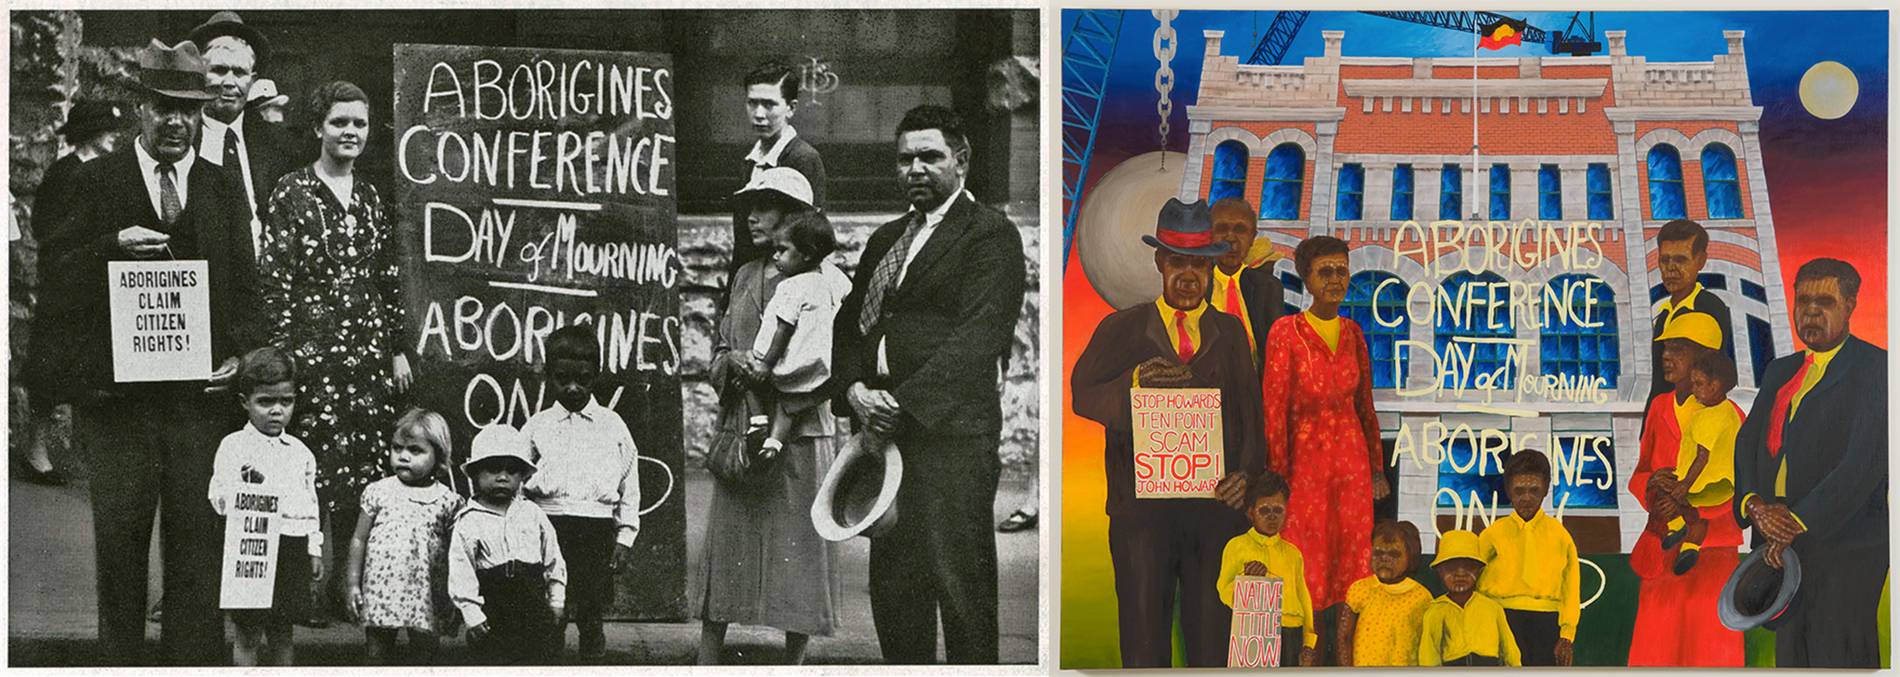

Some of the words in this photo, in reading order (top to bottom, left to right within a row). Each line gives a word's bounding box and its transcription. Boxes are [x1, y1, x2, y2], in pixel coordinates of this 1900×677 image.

[424, 60, 672, 119] ABORIGINES
[399, 125, 676, 196] CONFERENCE
[425, 202, 516, 268] DAY
[520, 232, 554, 282] of
[1394, 219, 1604, 279] ABORIGINES
[120, 270, 197, 288] ABORIGINES
[138, 292, 181, 309] CLAIM
[1373, 278, 1605, 330] CONFERENCE
[136, 313, 186, 331] CITIZEN
[133, 334, 190, 352] RIGHTS!
[416, 295, 680, 375] ABORINES
[1395, 340, 1475, 400] DAY
[1474, 366, 1505, 405] of
[1133, 394, 1166, 409] STOP
[1168, 394, 1222, 409] HOWARDS
[1137, 412, 1170, 429] TEN
[1175, 411, 1215, 430] POINT
[1150, 431, 1208, 453] SCAM
[1390, 421, 1613, 490] ABORINES
[1135, 453, 1219, 480] STOP!
[1136, 480, 1171, 493] JOHN
[1173, 479, 1218, 492] HOWAR
[234, 493, 279, 513] ABORIGINES
[244, 516, 269, 534] CLAIM
[240, 538, 268, 556] CITIZEN
[235, 560, 268, 579] RIGHTS!
[1234, 611, 1281, 637] TITLE
